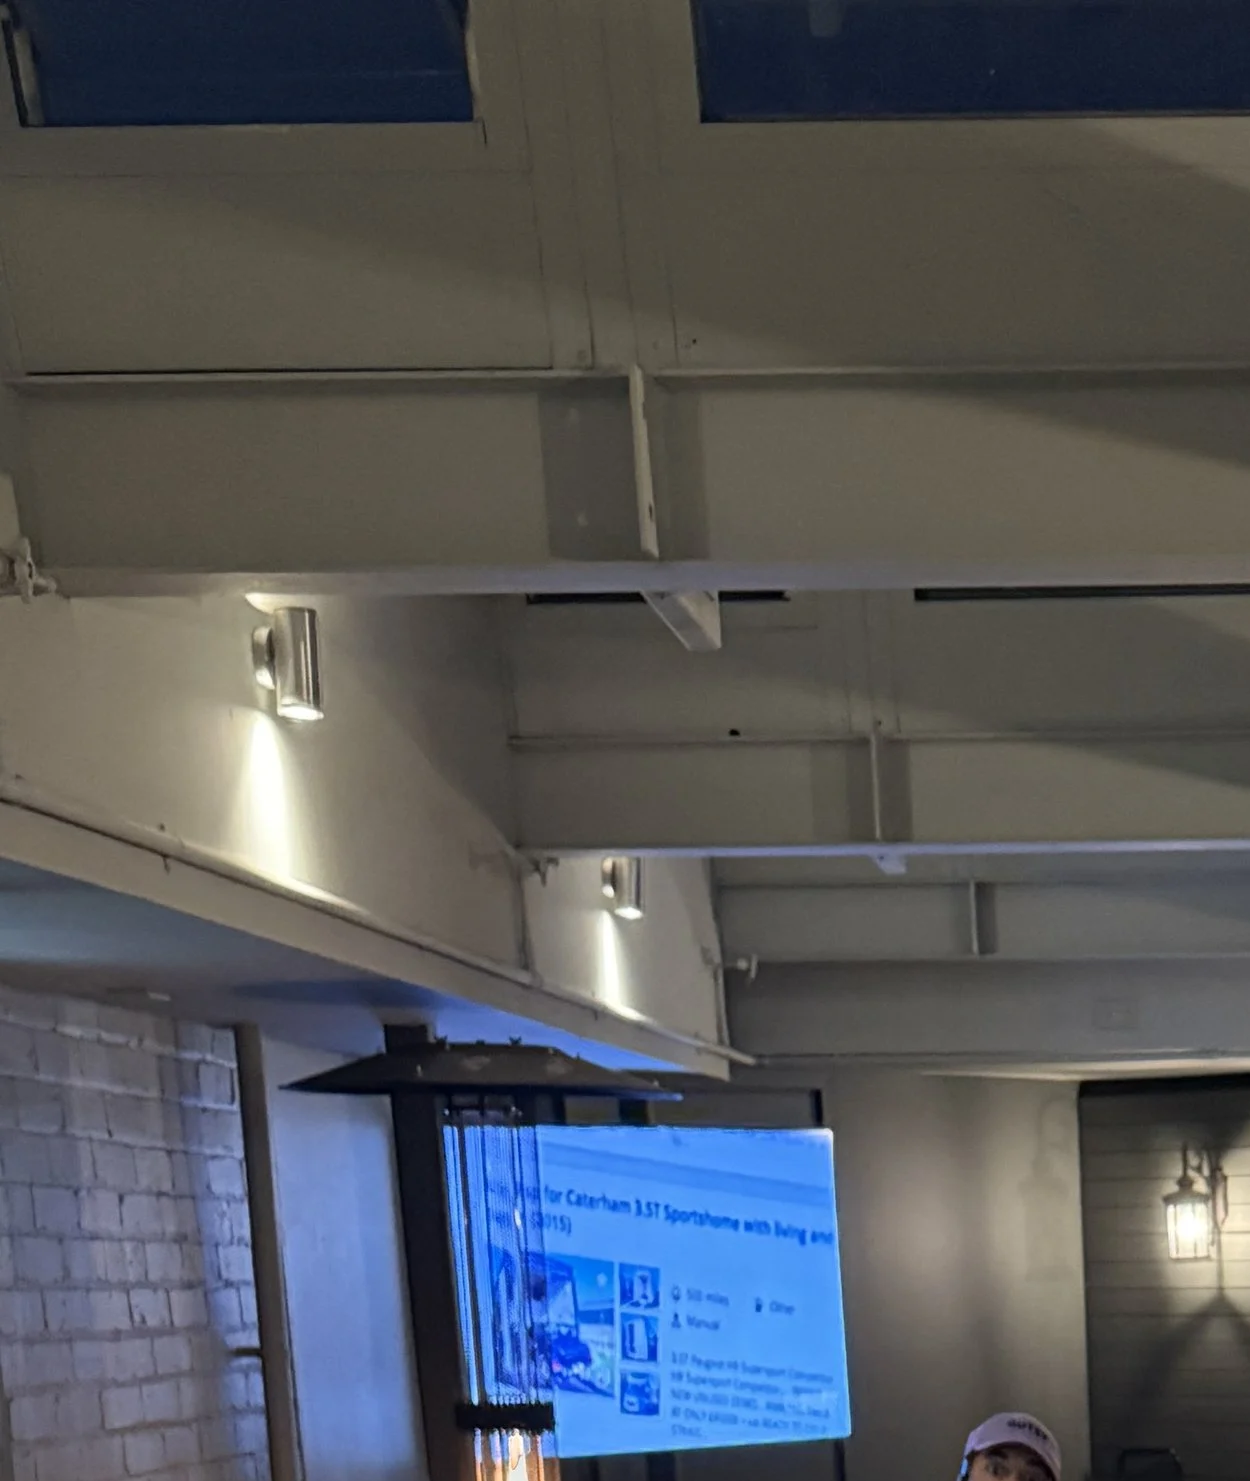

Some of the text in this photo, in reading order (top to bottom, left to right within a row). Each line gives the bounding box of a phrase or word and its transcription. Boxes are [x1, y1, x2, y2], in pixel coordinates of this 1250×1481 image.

[566, 1188, 632, 1214] Caterham
[663, 1203, 739, 1233] Sportshome
[743, 1219, 771, 1237] with
